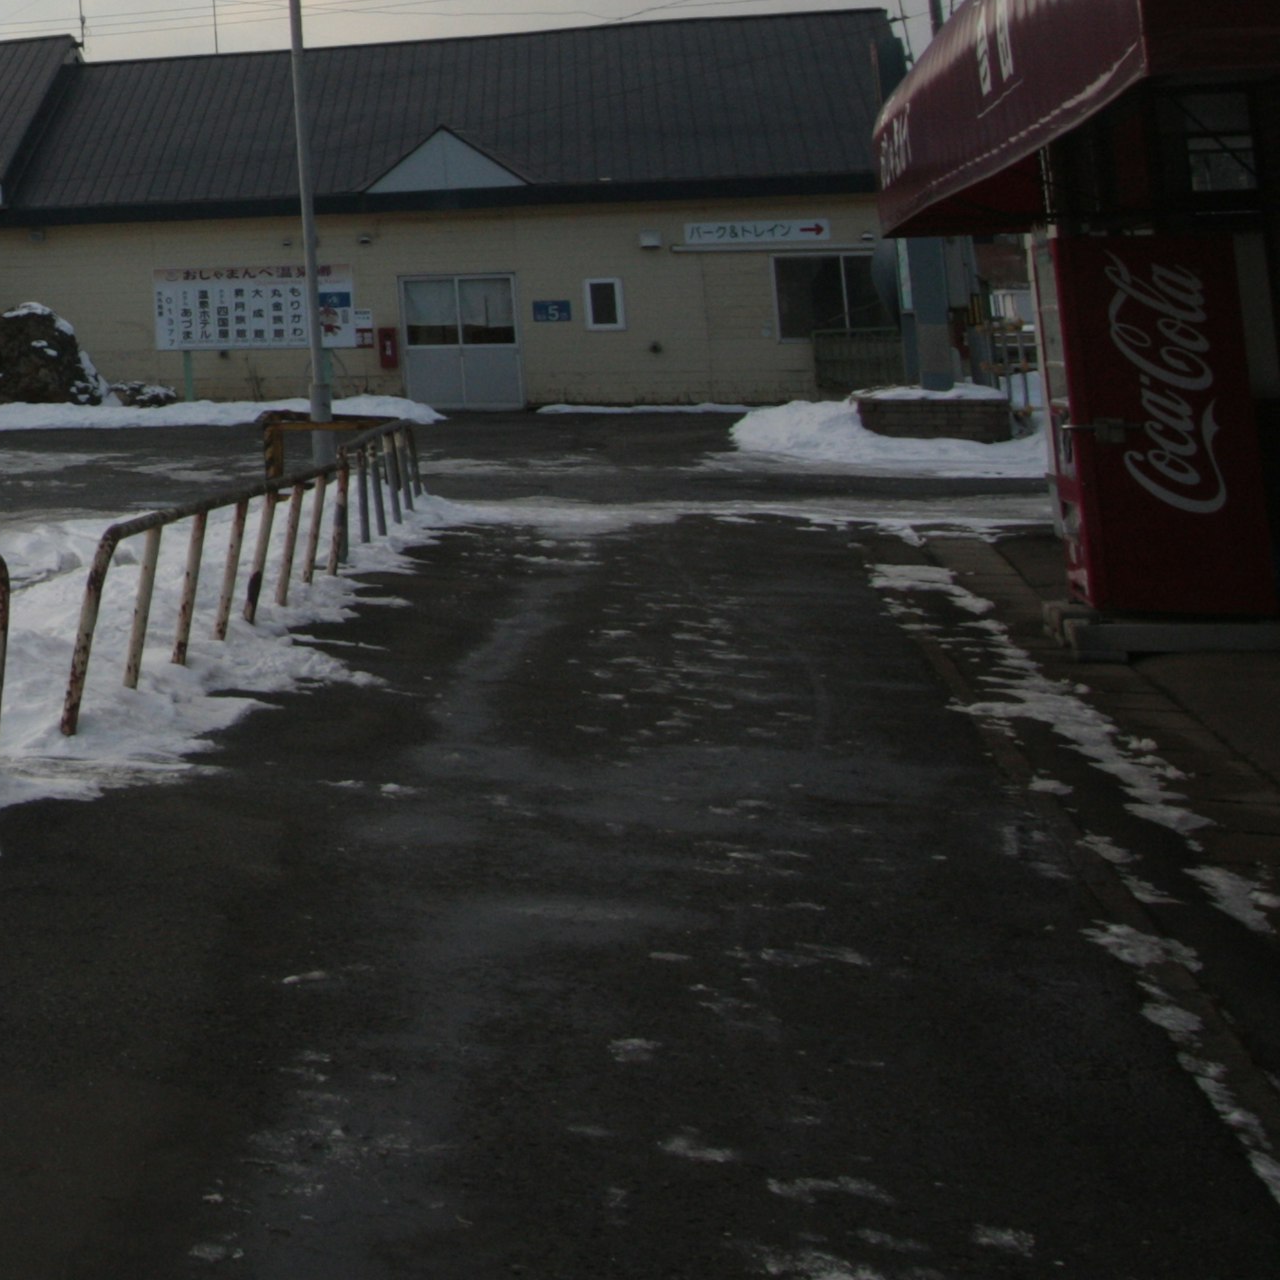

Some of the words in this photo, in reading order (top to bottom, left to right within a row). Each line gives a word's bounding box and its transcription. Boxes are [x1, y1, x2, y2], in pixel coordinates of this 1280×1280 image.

[181, 308, 192, 340] あづま
[548, 305, 559, 321] 5
[1104, 250, 1227, 513] Coca-Cola
